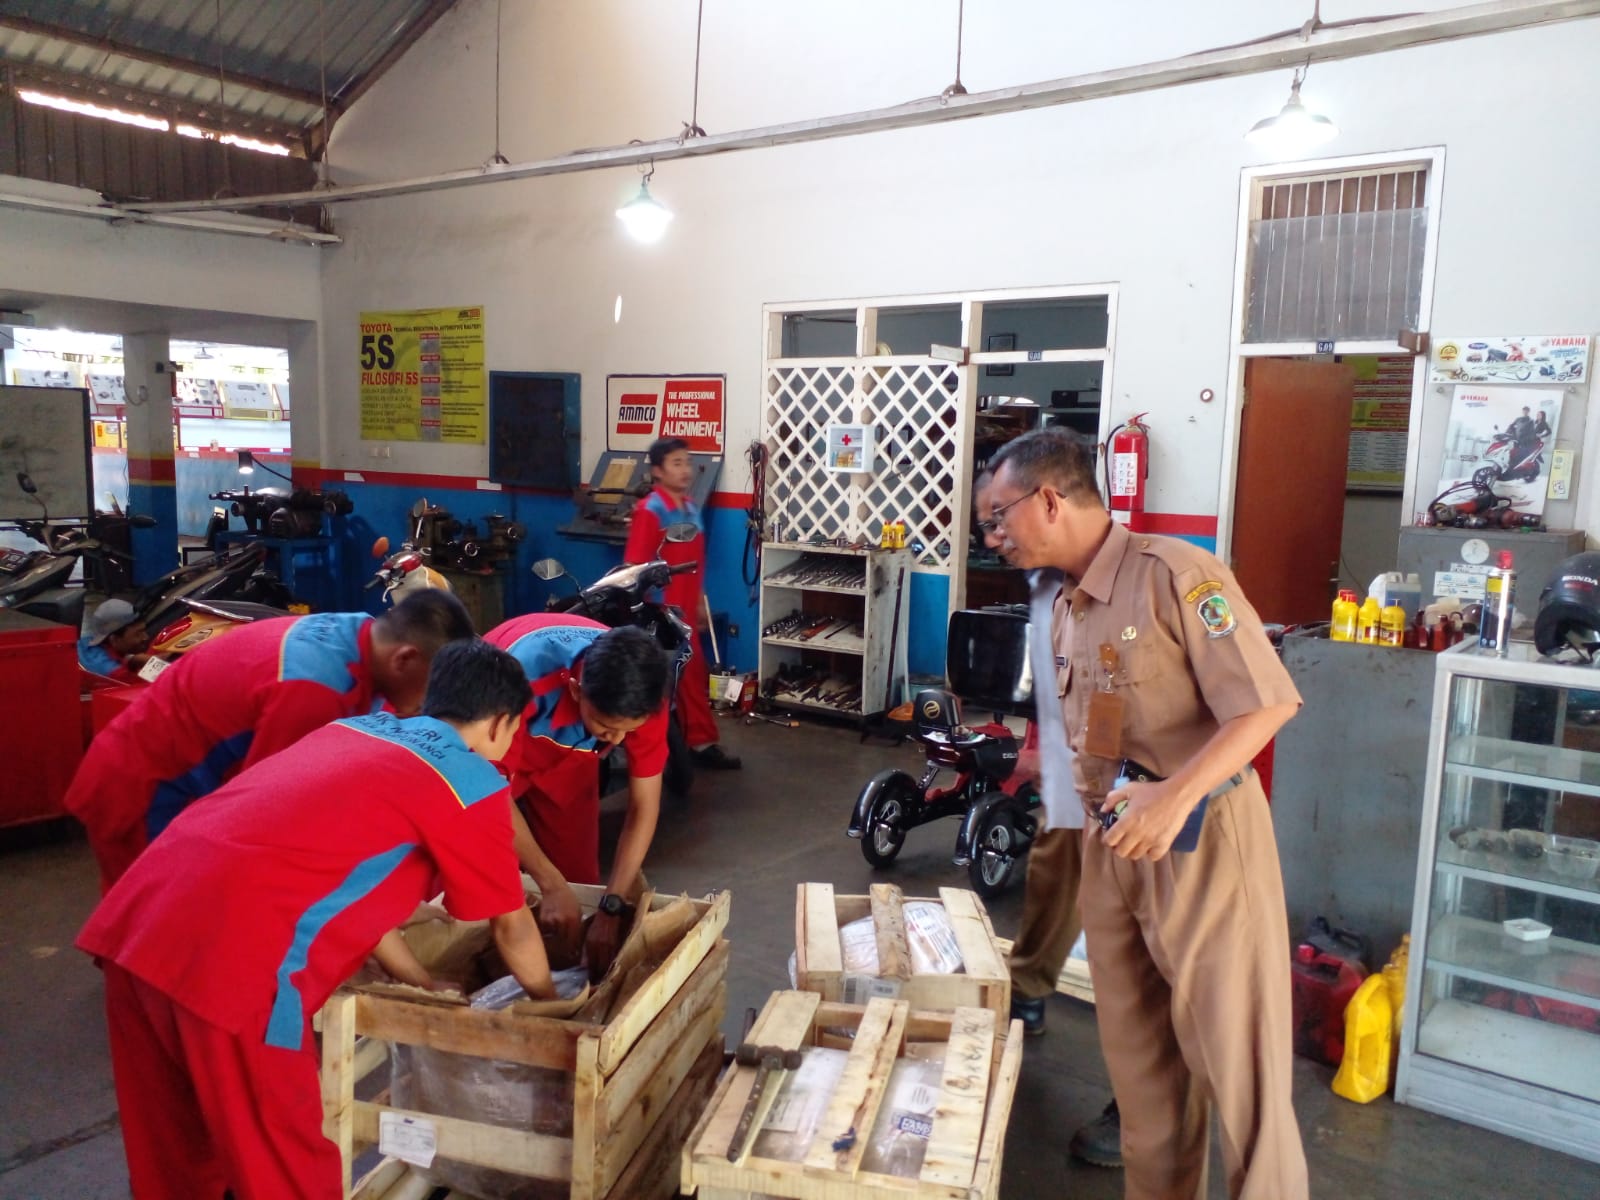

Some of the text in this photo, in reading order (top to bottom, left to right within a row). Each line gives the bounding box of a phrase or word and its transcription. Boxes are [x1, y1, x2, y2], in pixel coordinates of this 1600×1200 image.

[360, 323, 392, 333] TOYOTA
[1551, 337, 1587, 347] YAMAHA
[361, 334, 395, 370] 5S
[361, 371, 404, 385] FILOSOFI
[405, 371, 419, 385] 5S
[668, 391, 716, 400] THE PROFESSIONAL
[618, 406, 656, 421] AMMCO
[666, 402, 700, 418] WHEEL
[662, 421, 719, 437] ALIGNMENT
[1561, 575, 1598, 586] HONDA
